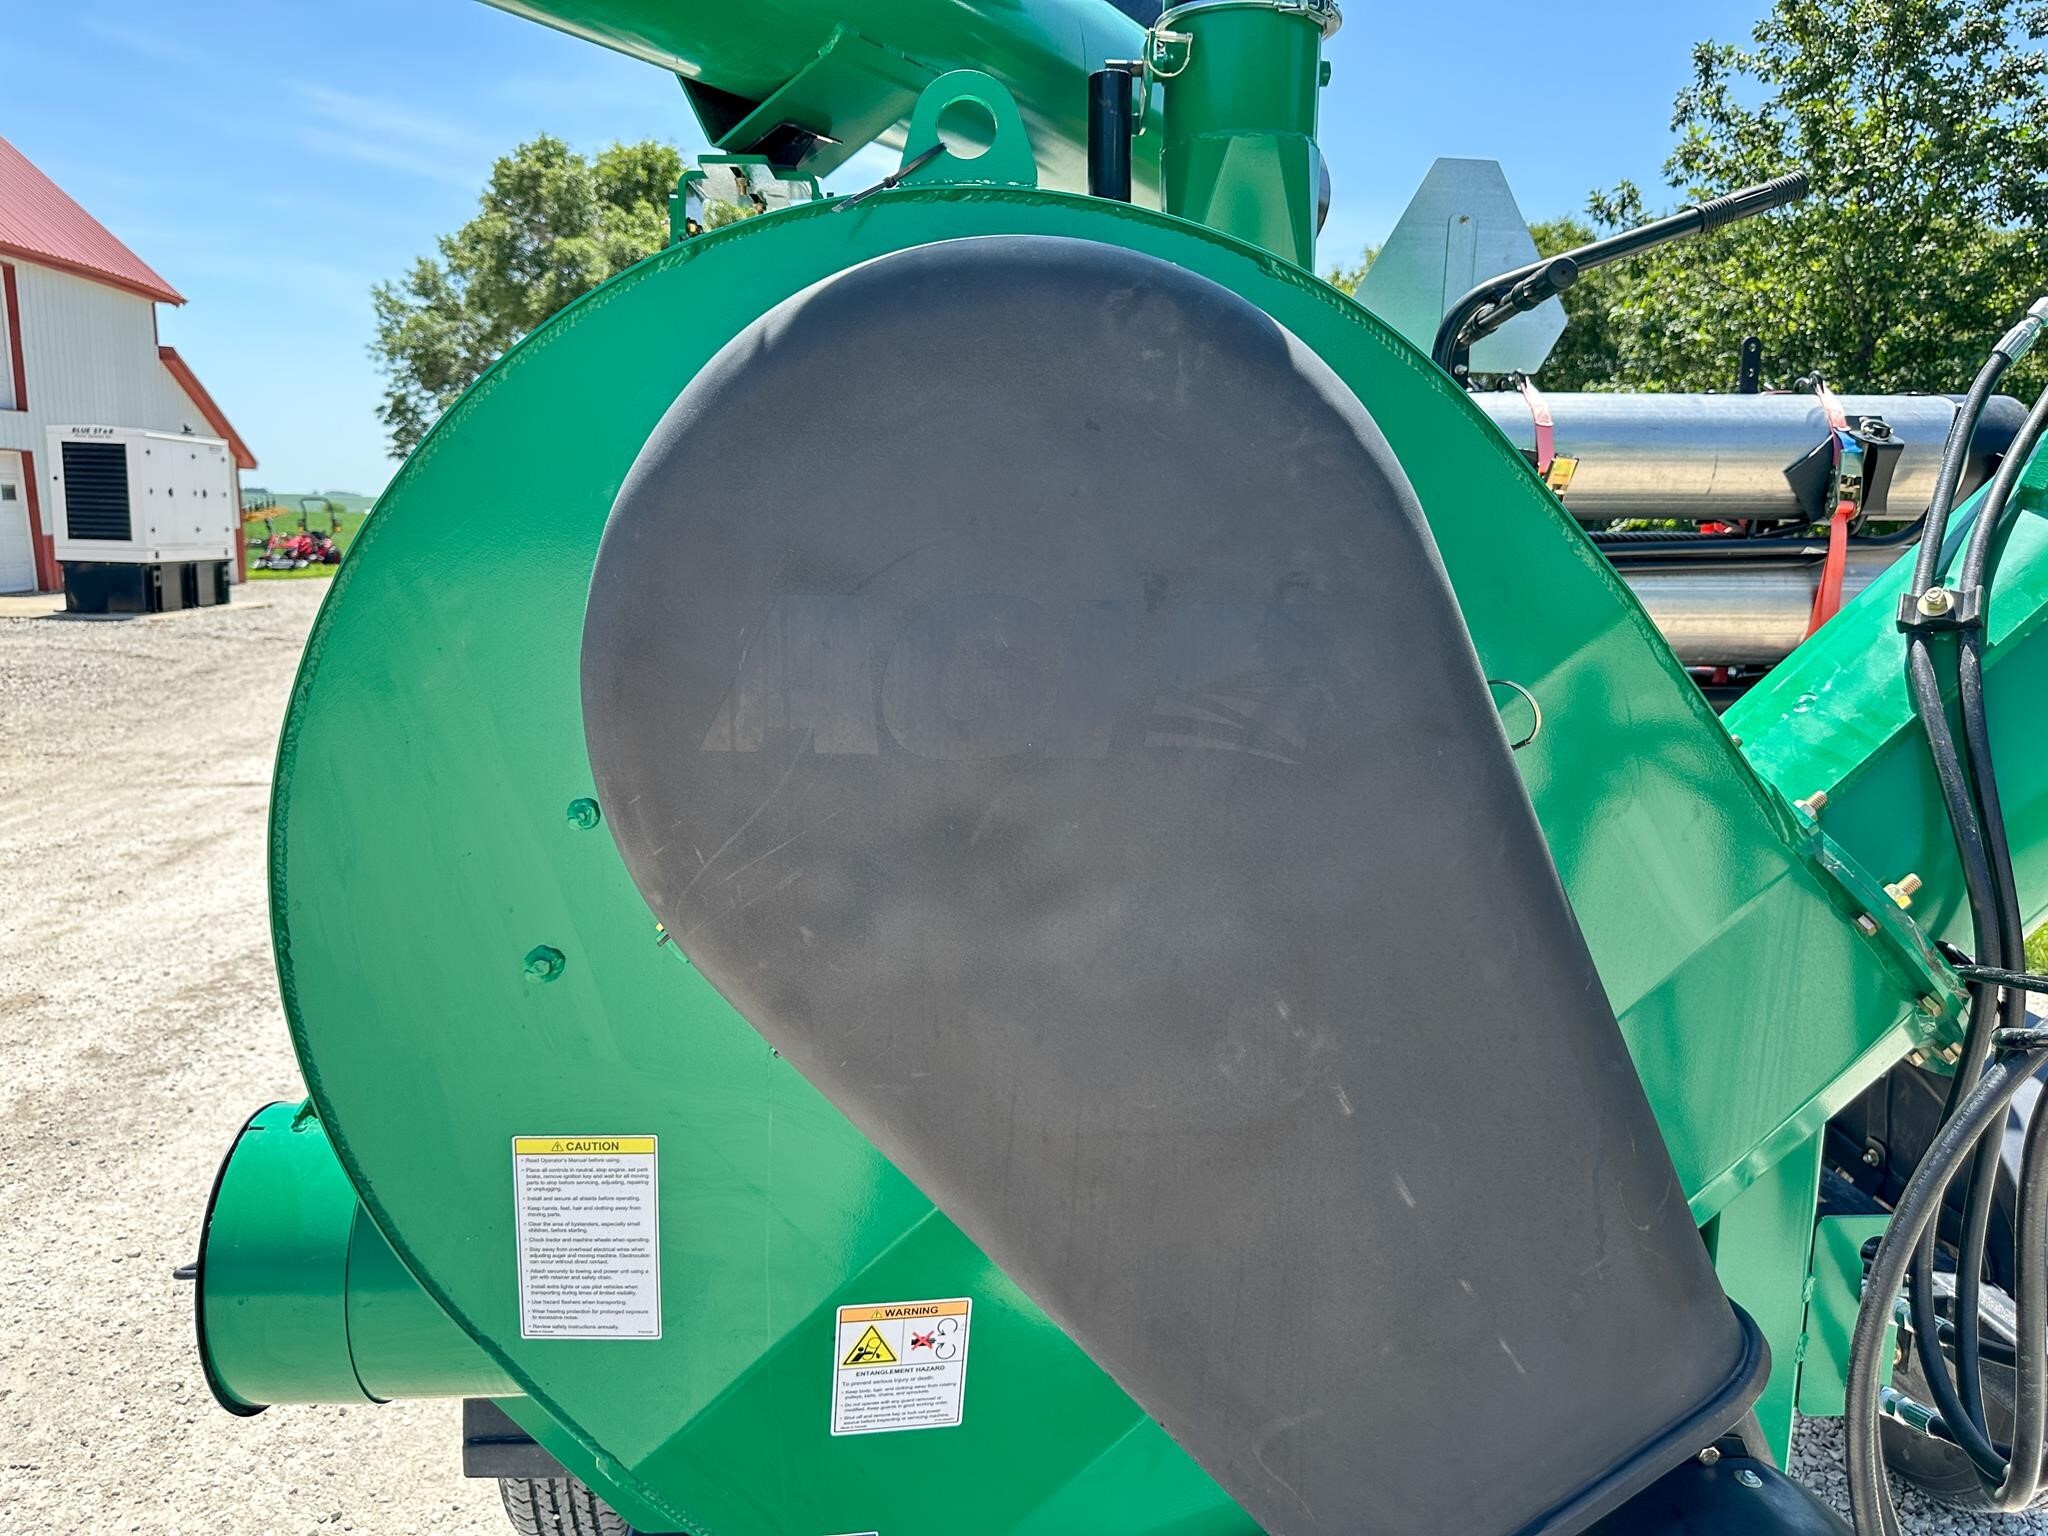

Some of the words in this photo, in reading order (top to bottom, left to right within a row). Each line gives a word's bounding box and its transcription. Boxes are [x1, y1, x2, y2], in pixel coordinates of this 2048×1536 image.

[566, 1142, 619, 1151] CAUTION
[885, 1306, 939, 1317] WARNING
[856, 1368, 914, 1377] ENTANGLEMENT
